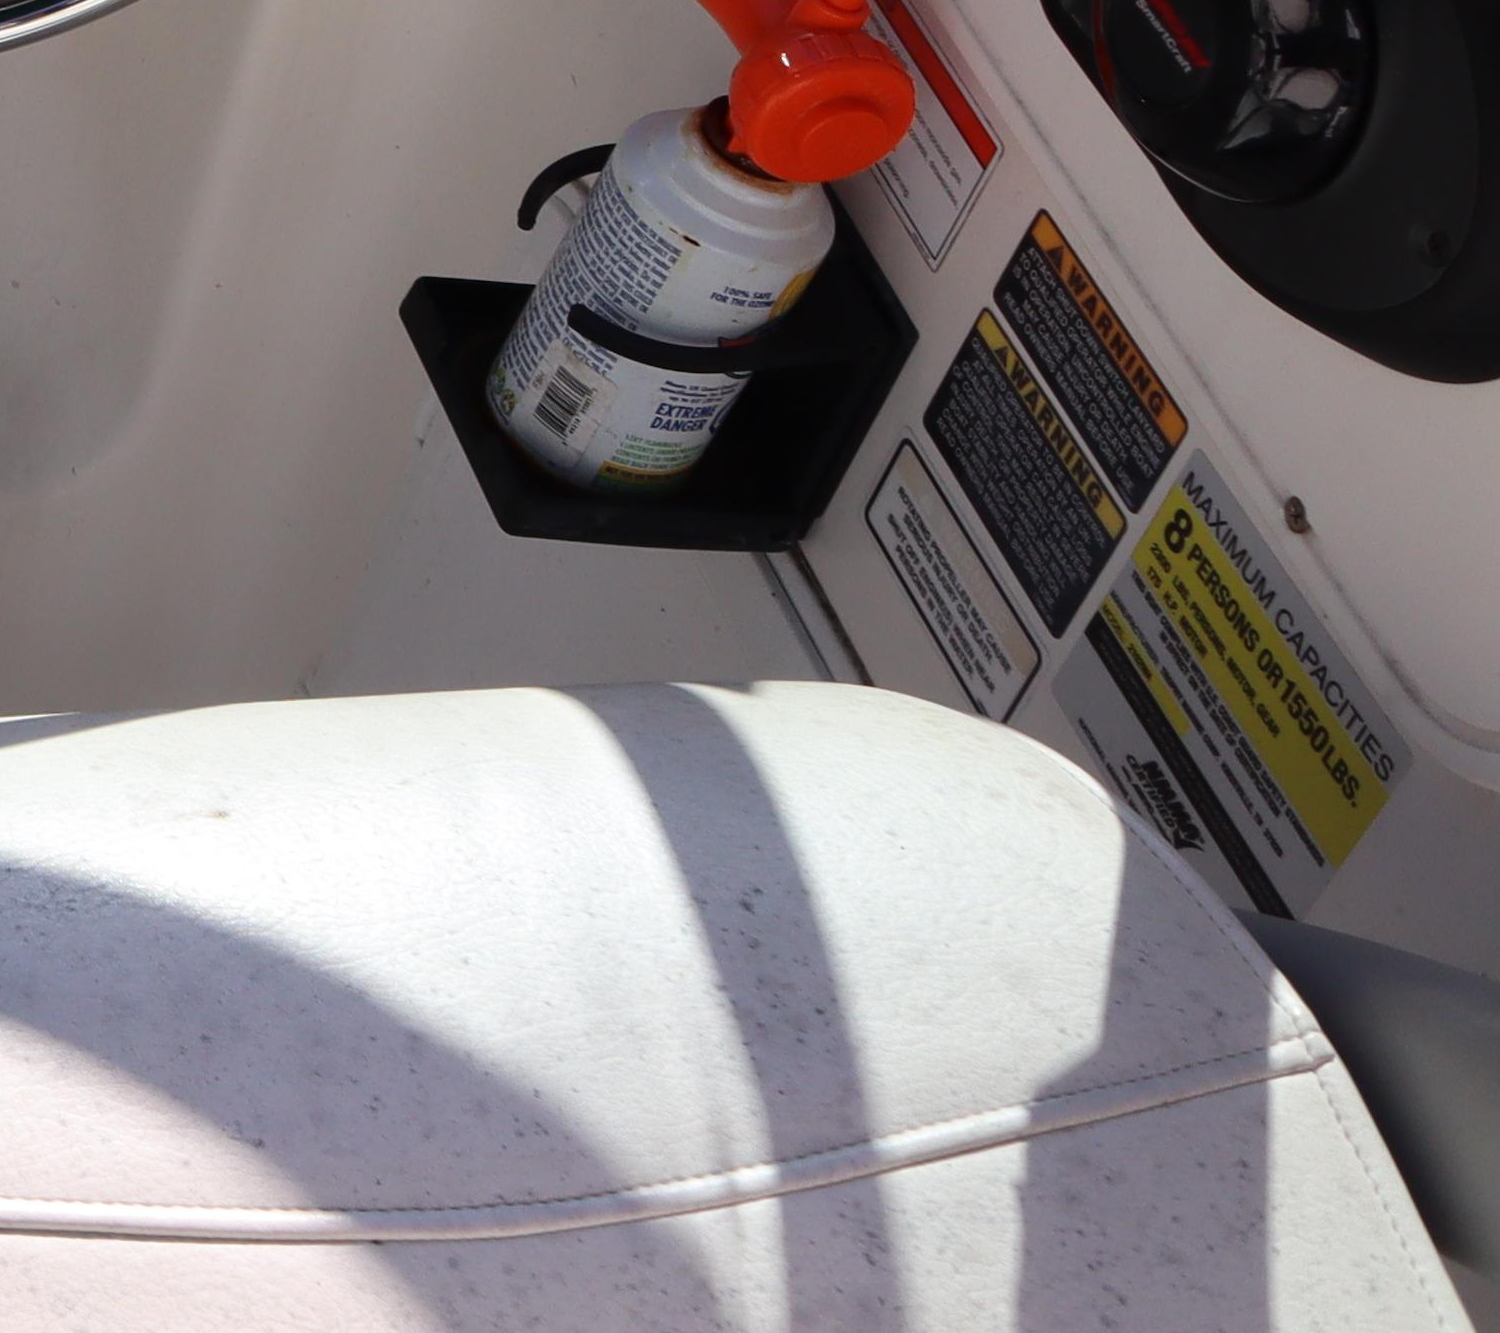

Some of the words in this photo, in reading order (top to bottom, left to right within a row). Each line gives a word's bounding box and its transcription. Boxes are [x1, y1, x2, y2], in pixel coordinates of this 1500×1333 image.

[655, 403, 718, 419] EXTREME
[1063, 264, 1167, 420] WARNING
[650, 416, 709, 432] DANGER
[1007, 361, 1104, 511] WARNING
[1159, 501, 1197, 559] 8
[1184, 541, 1262, 655] PERSONS
[1254, 643, 1286, 692] OR
[1276, 675, 1331, 756] 1550
[1319, 741, 1366, 810] LBS.
[1179, 468, 1277, 611] MAXIMUM
[1271, 602, 1396, 786] CAPACITIES
